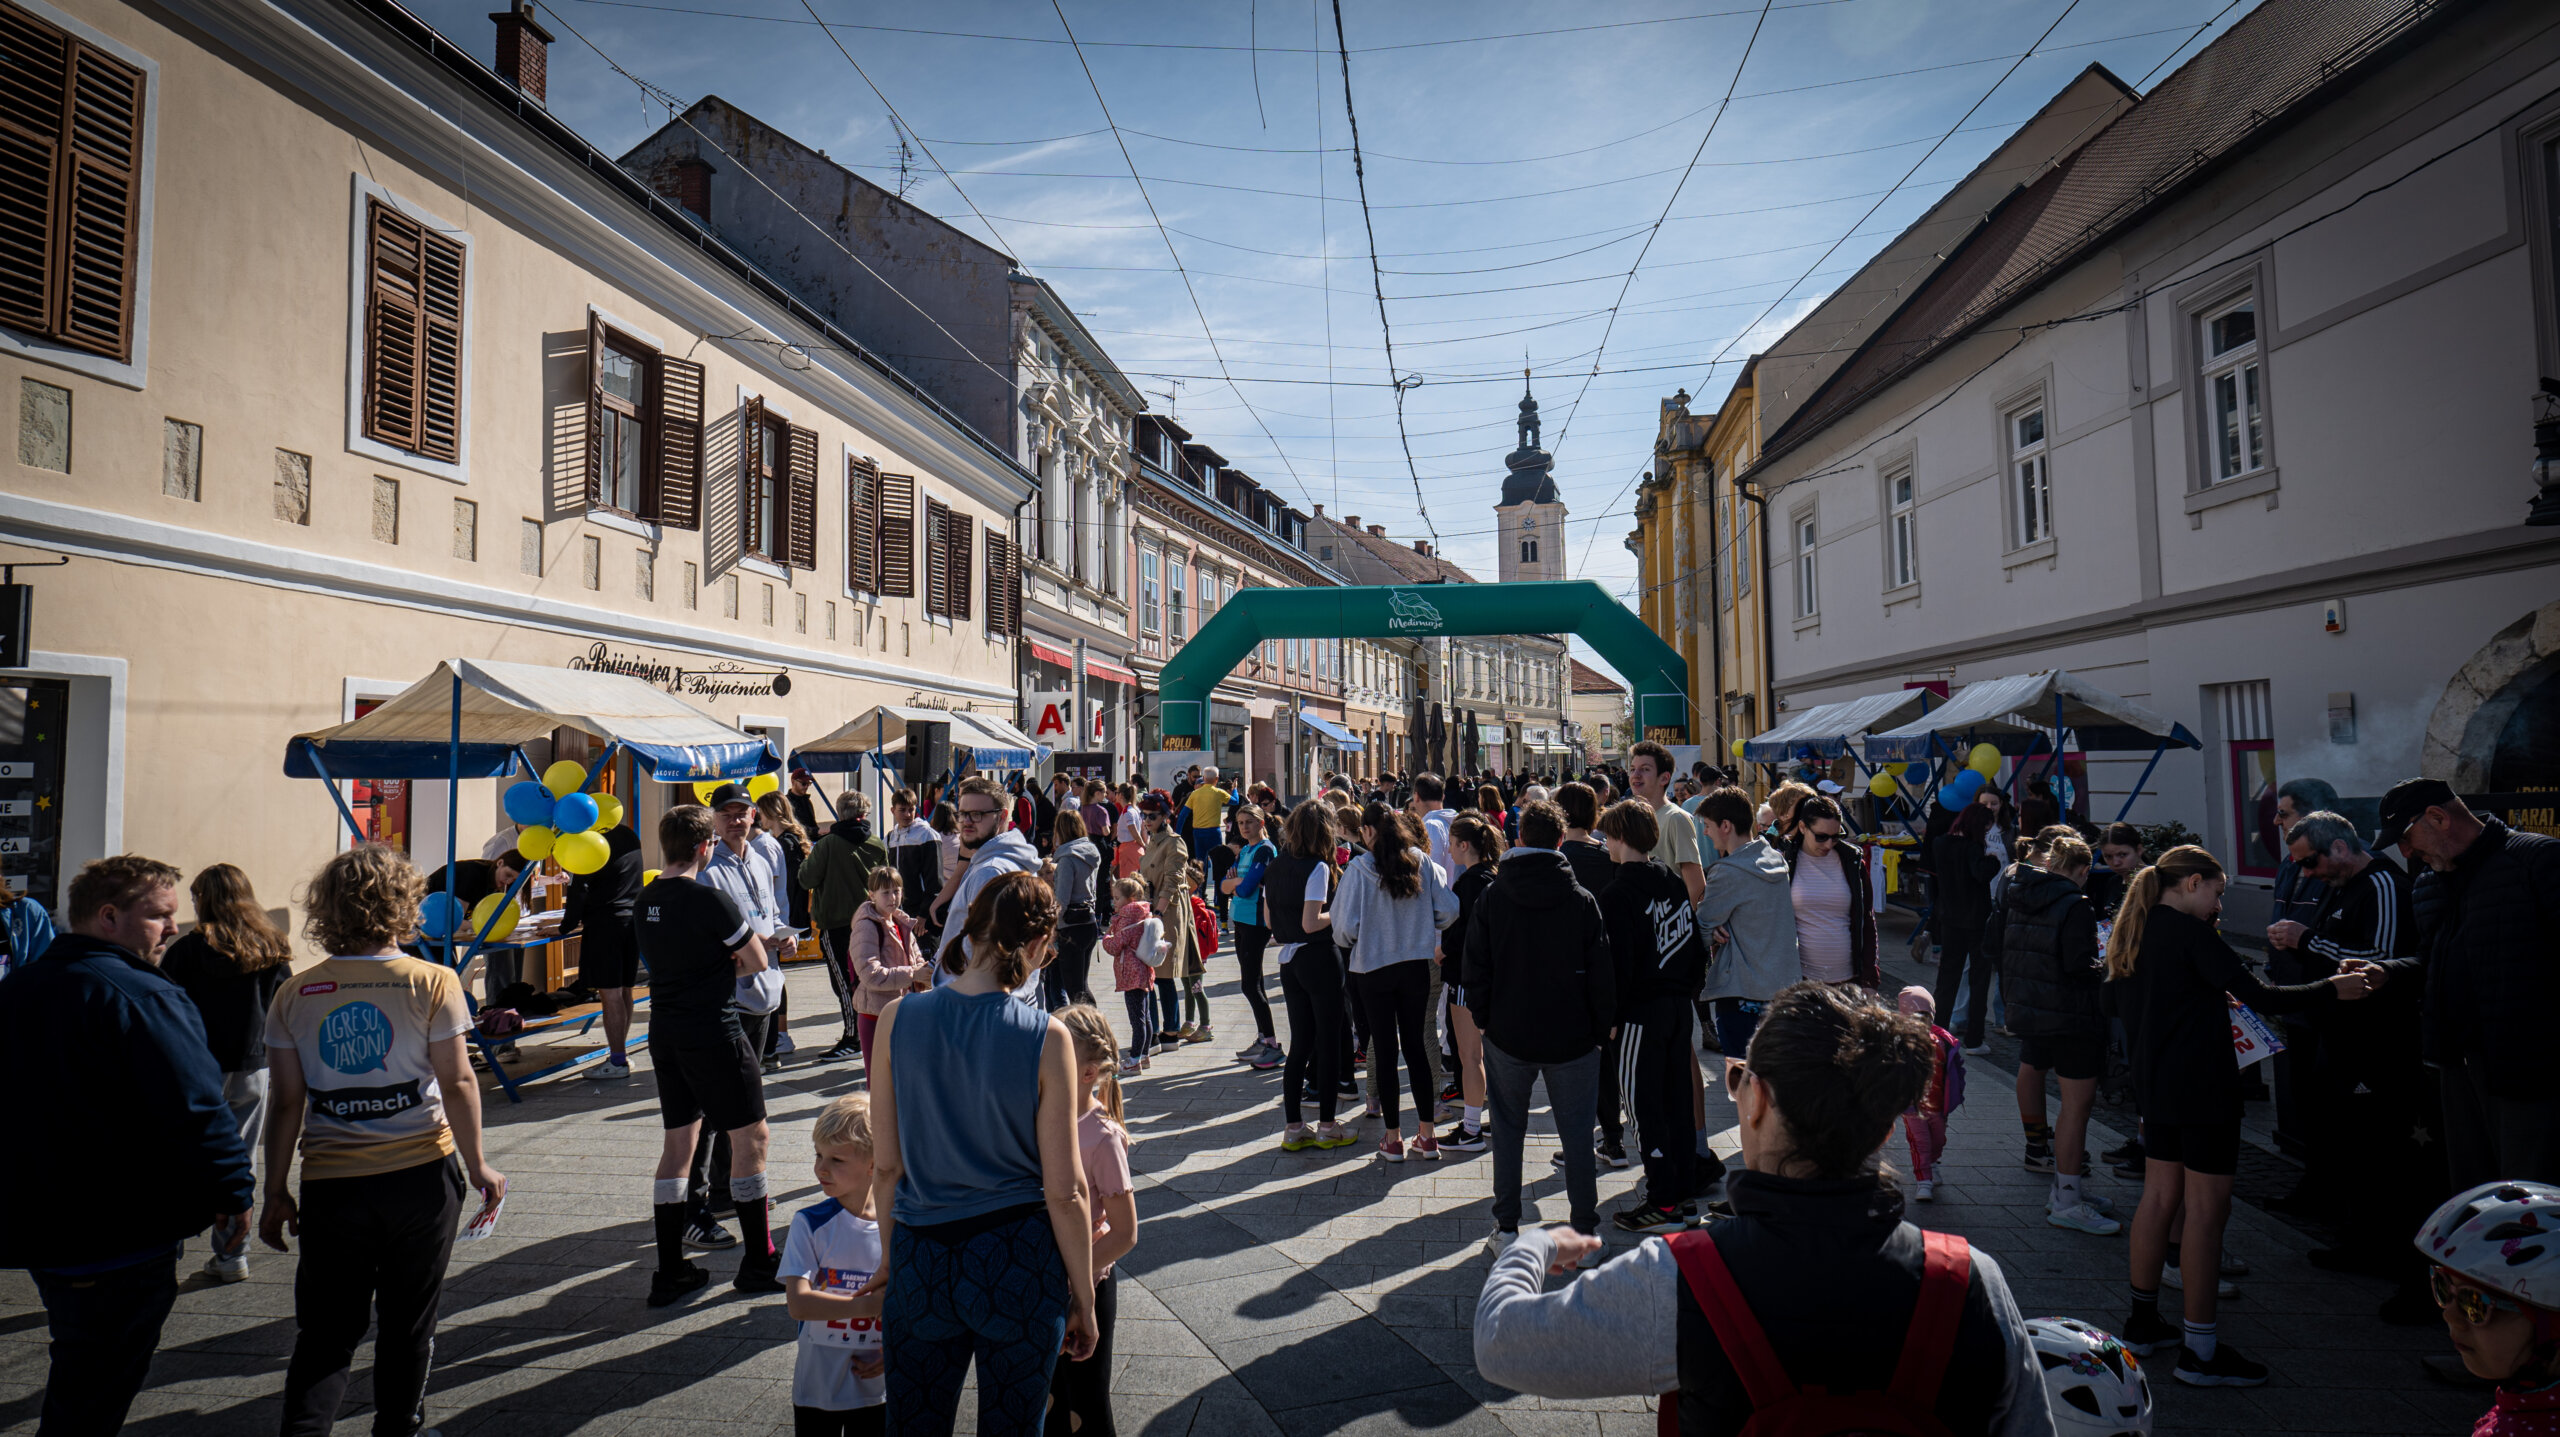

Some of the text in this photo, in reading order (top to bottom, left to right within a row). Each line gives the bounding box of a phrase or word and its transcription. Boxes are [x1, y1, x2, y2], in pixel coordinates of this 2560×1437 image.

[688, 674, 771, 703] Brijačnica
[1036, 698, 1072, 735] A1
[1169, 737, 1192, 748] POLU
[1653, 727, 1678, 739] POLU
[654, 769, 680, 777] AKOVEC
[647, 906, 661, 916] MX
[326, 1006, 360, 1043] IGRE
[331, 1028, 387, 1071] ZAKON!
